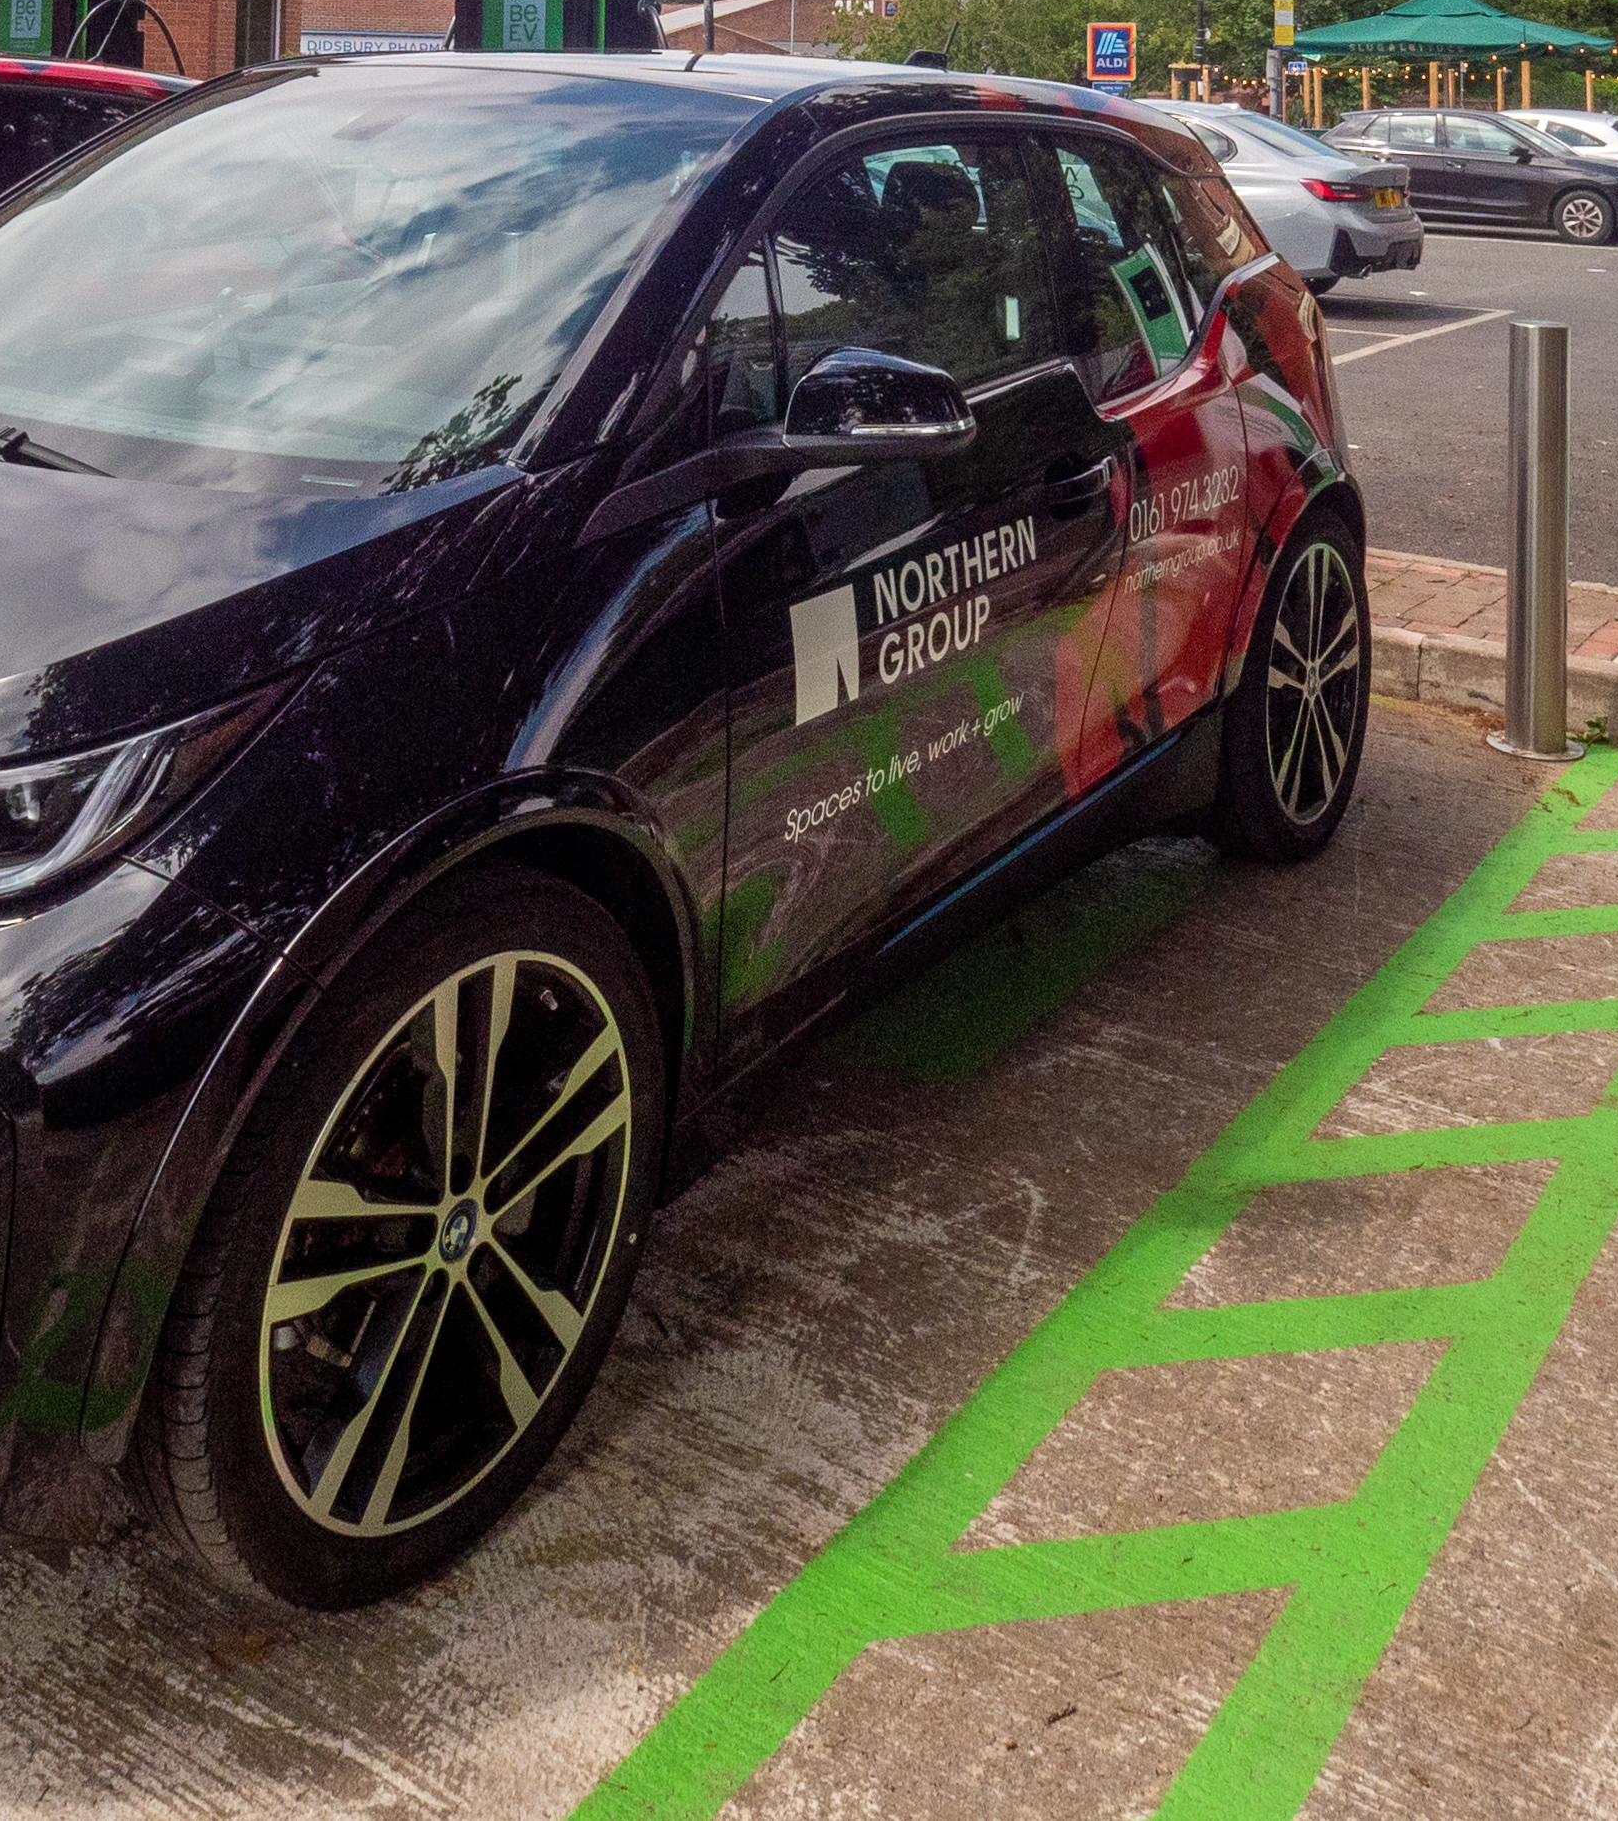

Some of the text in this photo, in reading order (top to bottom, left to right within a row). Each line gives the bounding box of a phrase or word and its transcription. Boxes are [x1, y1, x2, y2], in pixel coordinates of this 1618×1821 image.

[15, 16, 36, 32] EV
[307, 40, 384, 53] DIDSBURY
[509, 23, 538, 42] EV
[1096, 57, 1128, 68] ALDI
[1129, 464, 1240, 543] 0161 974 3232
[872, 515, 1037, 625] NORTHERN
[1124, 525, 1241, 595] northerngroup.co.uk
[878, 594, 990, 685] GROUP
[784, 690, 1026, 844] Spaces to live, work + grow
